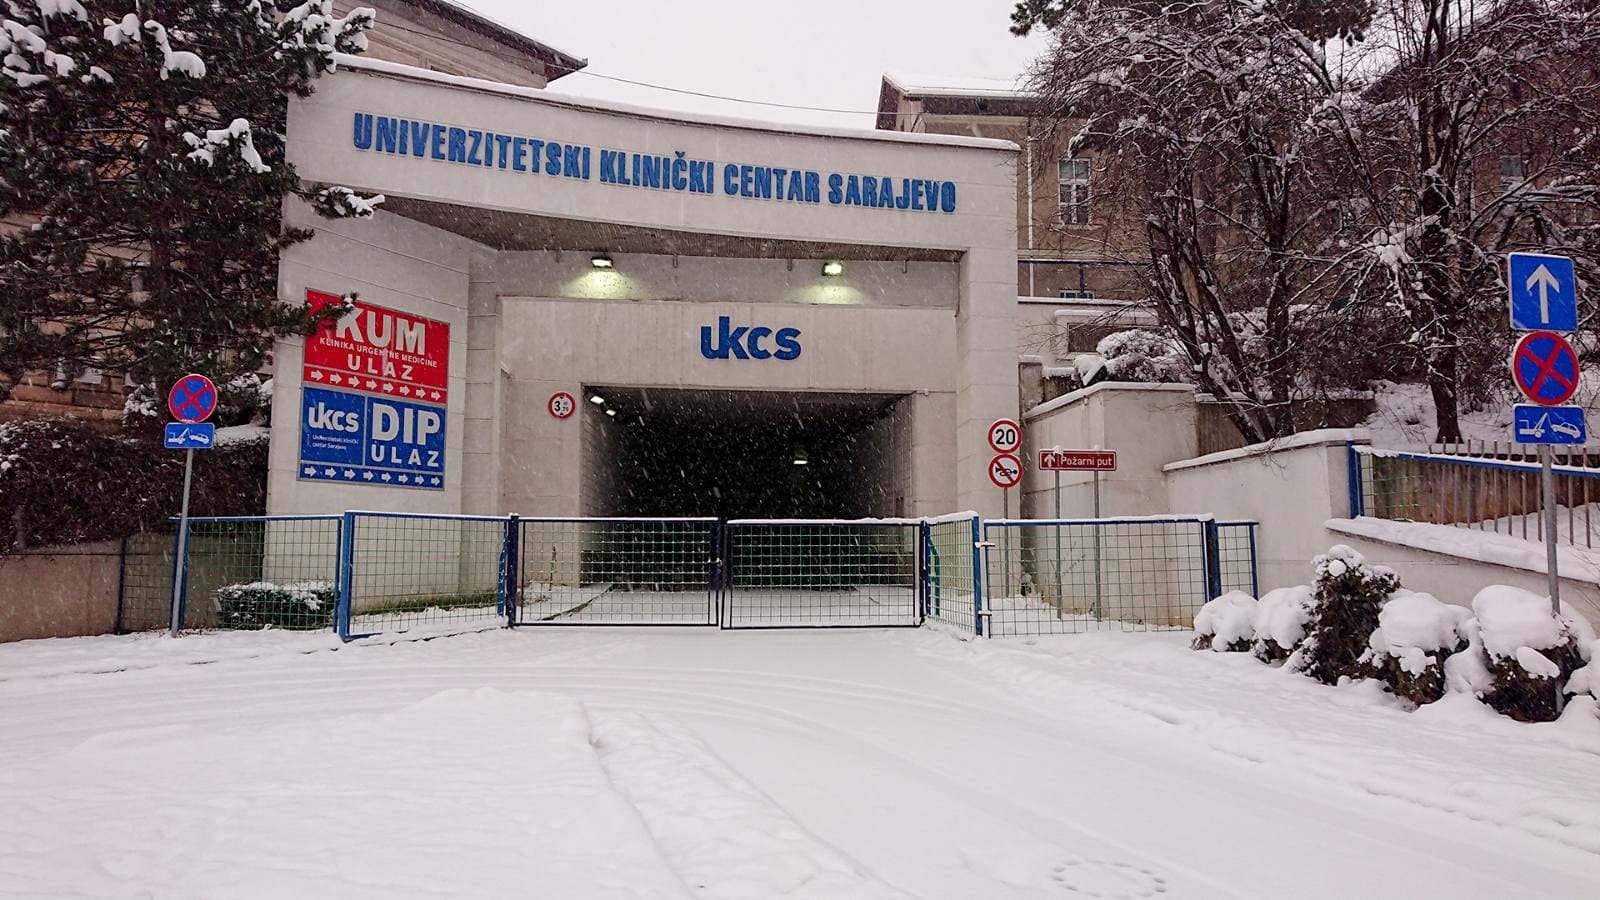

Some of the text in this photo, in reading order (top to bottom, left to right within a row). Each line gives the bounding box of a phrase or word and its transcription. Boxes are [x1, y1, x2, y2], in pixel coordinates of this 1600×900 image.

[353, 112, 956, 213] UNIVERZITETSKI KLINIČKI CENTAR SARAJEVO
[336, 306, 425, 355] KUM
[320, 336, 438, 368] KLINIKA URGENNE MEDICINE
[347, 353, 413, 380] ULAZ
[372, 402, 441, 446] DIP
[995, 428, 1016, 445] 20
[371, 444, 439, 468] ULAZ
[1060, 455, 1113, 468] Požarni put
